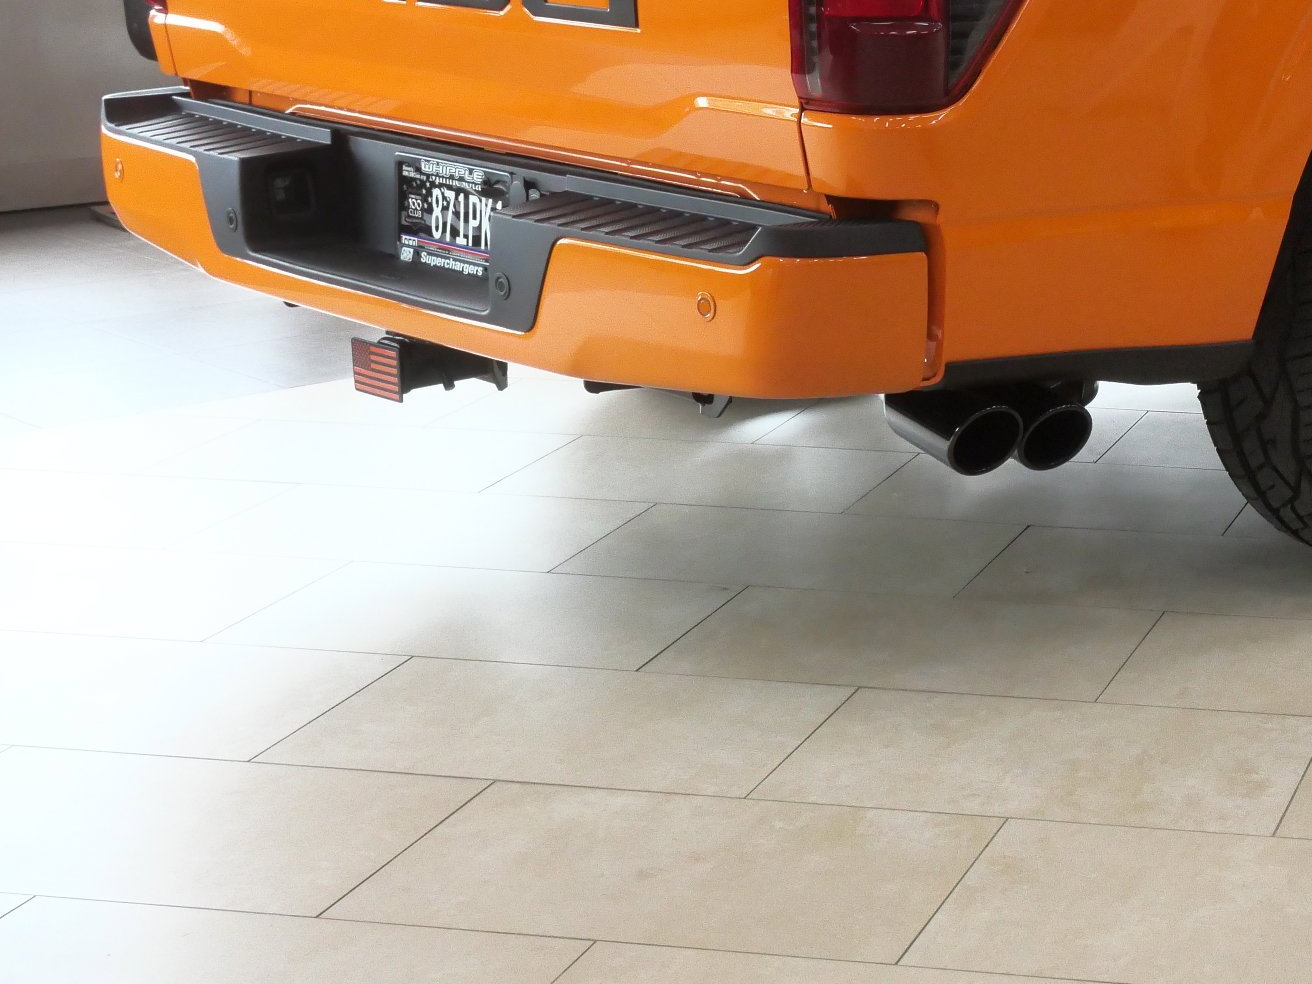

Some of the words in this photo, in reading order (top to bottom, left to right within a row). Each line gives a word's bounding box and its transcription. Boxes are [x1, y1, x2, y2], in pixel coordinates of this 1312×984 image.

[421, 159, 484, 184] WHIPPLE
[432, 187, 503, 251] 871PK
[420, 251, 483, 276] Superchargers
